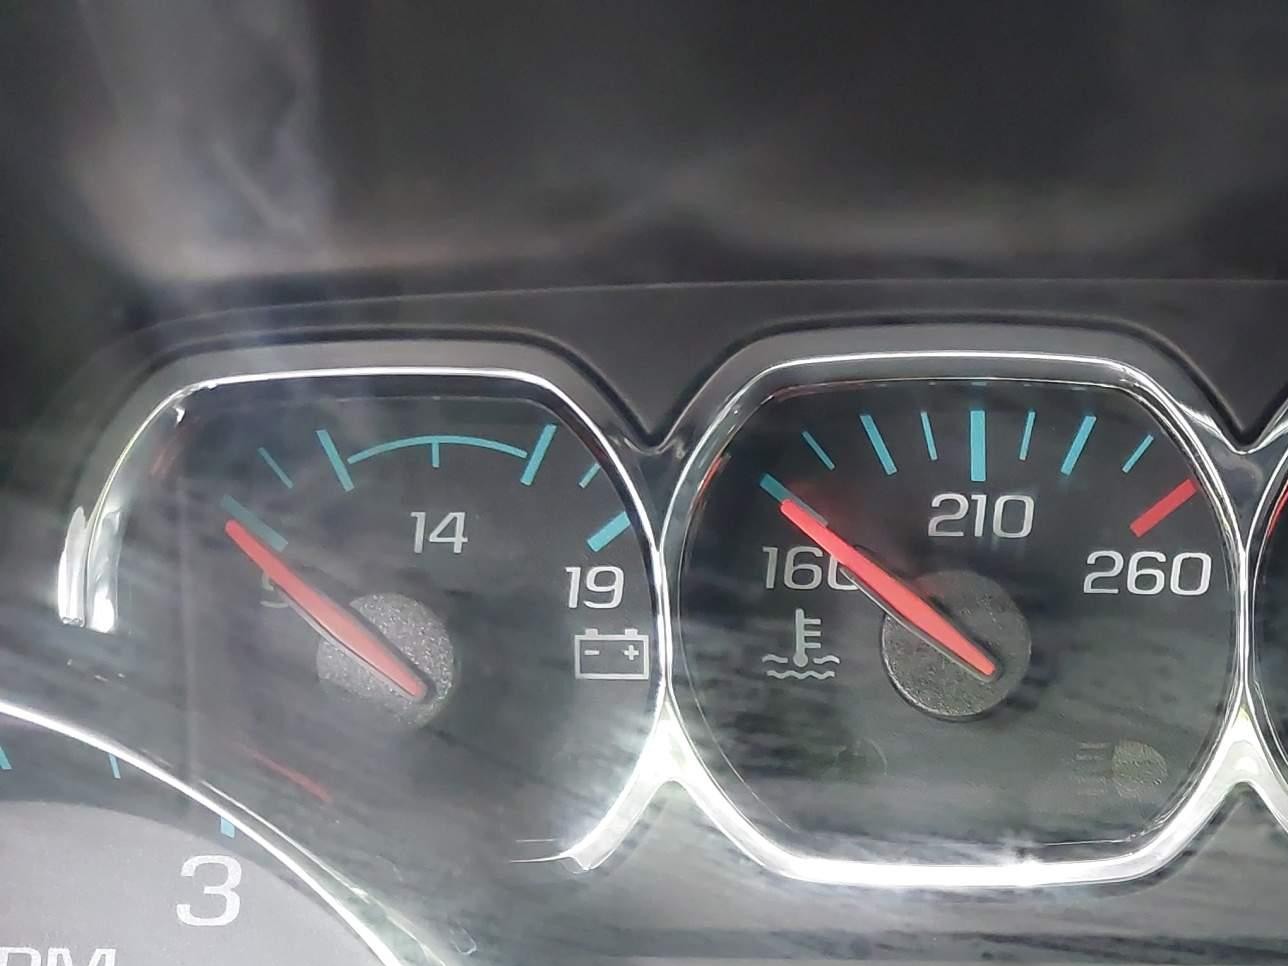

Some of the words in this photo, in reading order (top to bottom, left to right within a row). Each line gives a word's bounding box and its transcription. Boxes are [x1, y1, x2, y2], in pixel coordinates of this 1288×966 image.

[411, 512, 468, 553] 14
[929, 493, 1034, 537] 210
[566, 566, 623, 608] 19
[1084, 551, 1211, 595] 260
[177, 855, 241, 926] 3
